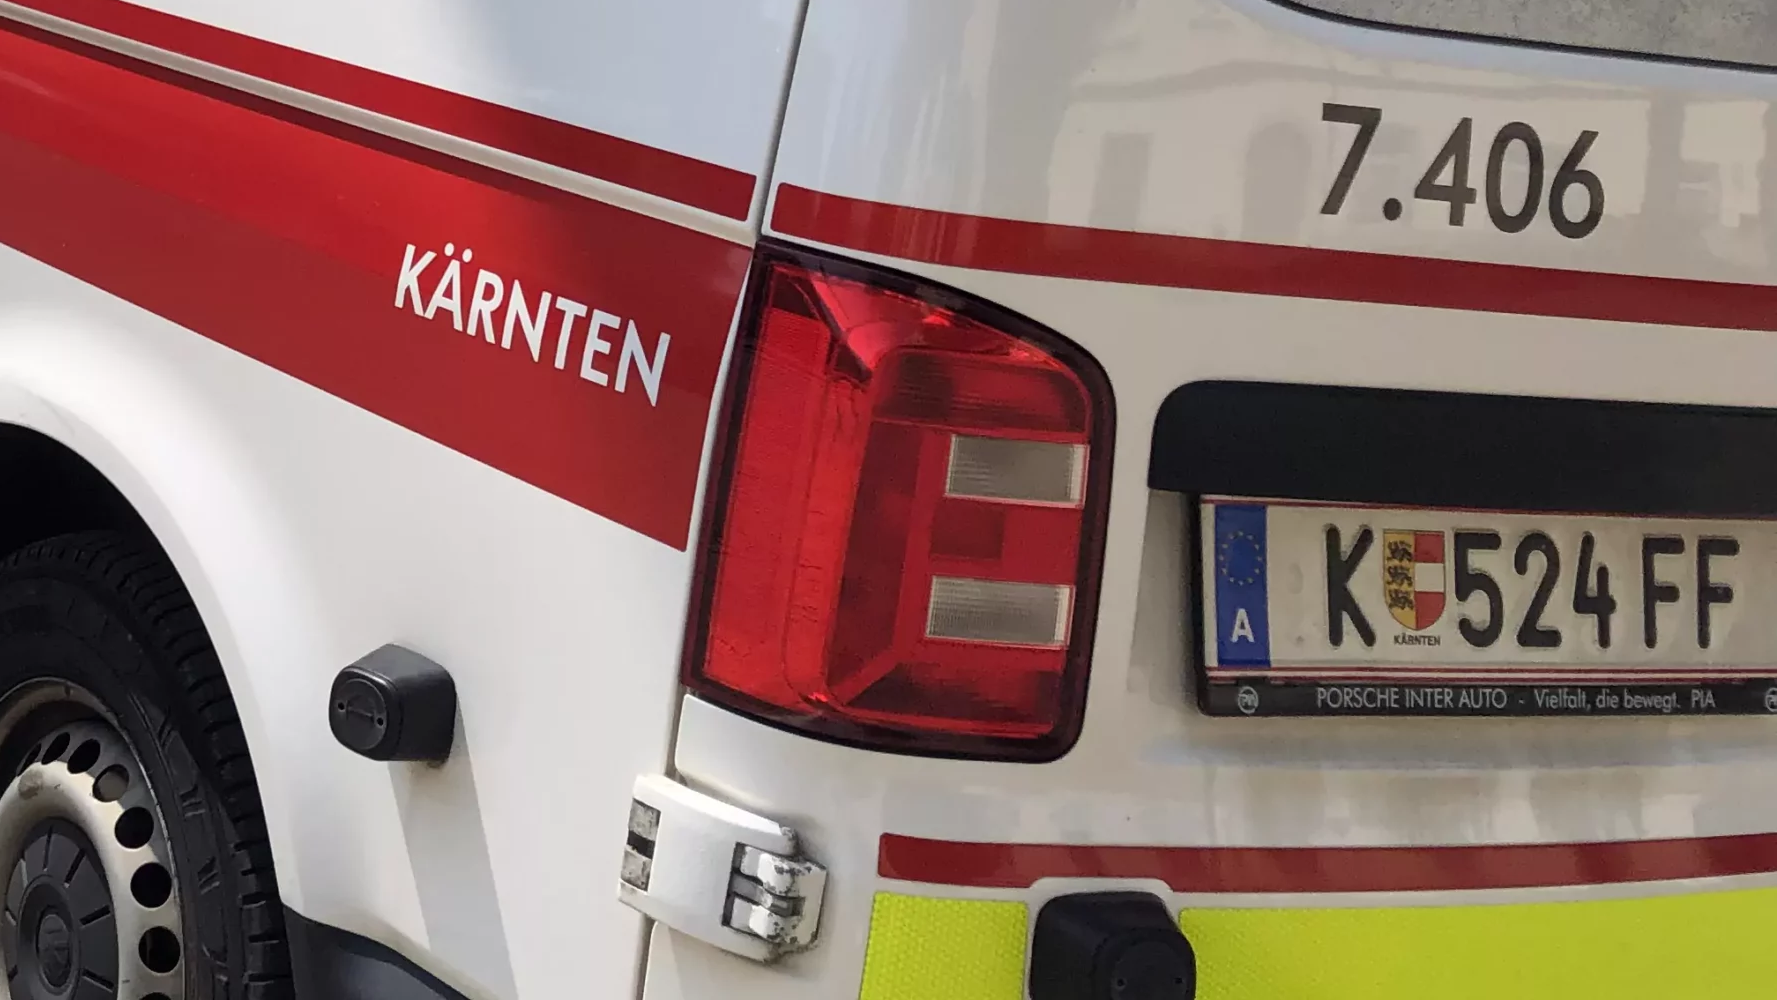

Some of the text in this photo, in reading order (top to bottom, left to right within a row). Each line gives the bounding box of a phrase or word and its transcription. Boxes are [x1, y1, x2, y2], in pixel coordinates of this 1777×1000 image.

[1320, 102, 1605, 239] 7.406
[394, 242, 671, 407] KÄRNTEN
[1325, 524, 1376, 648] K
[1230, 609, 1255, 643] A
[1393, 632, 1441, 646] KÄRNTEN
[1317, 687, 1400, 709] PORSCHE
[1405, 687, 1454, 709] INTER
[1458, 687, 1508, 709] AUTO
[1534, 688, 1592, 712] Vielfalt,
[1596, 689, 1619, 708] die
[1623, 689, 1681, 713] bewegt.
[1691, 689, 1716, 708] PIA
